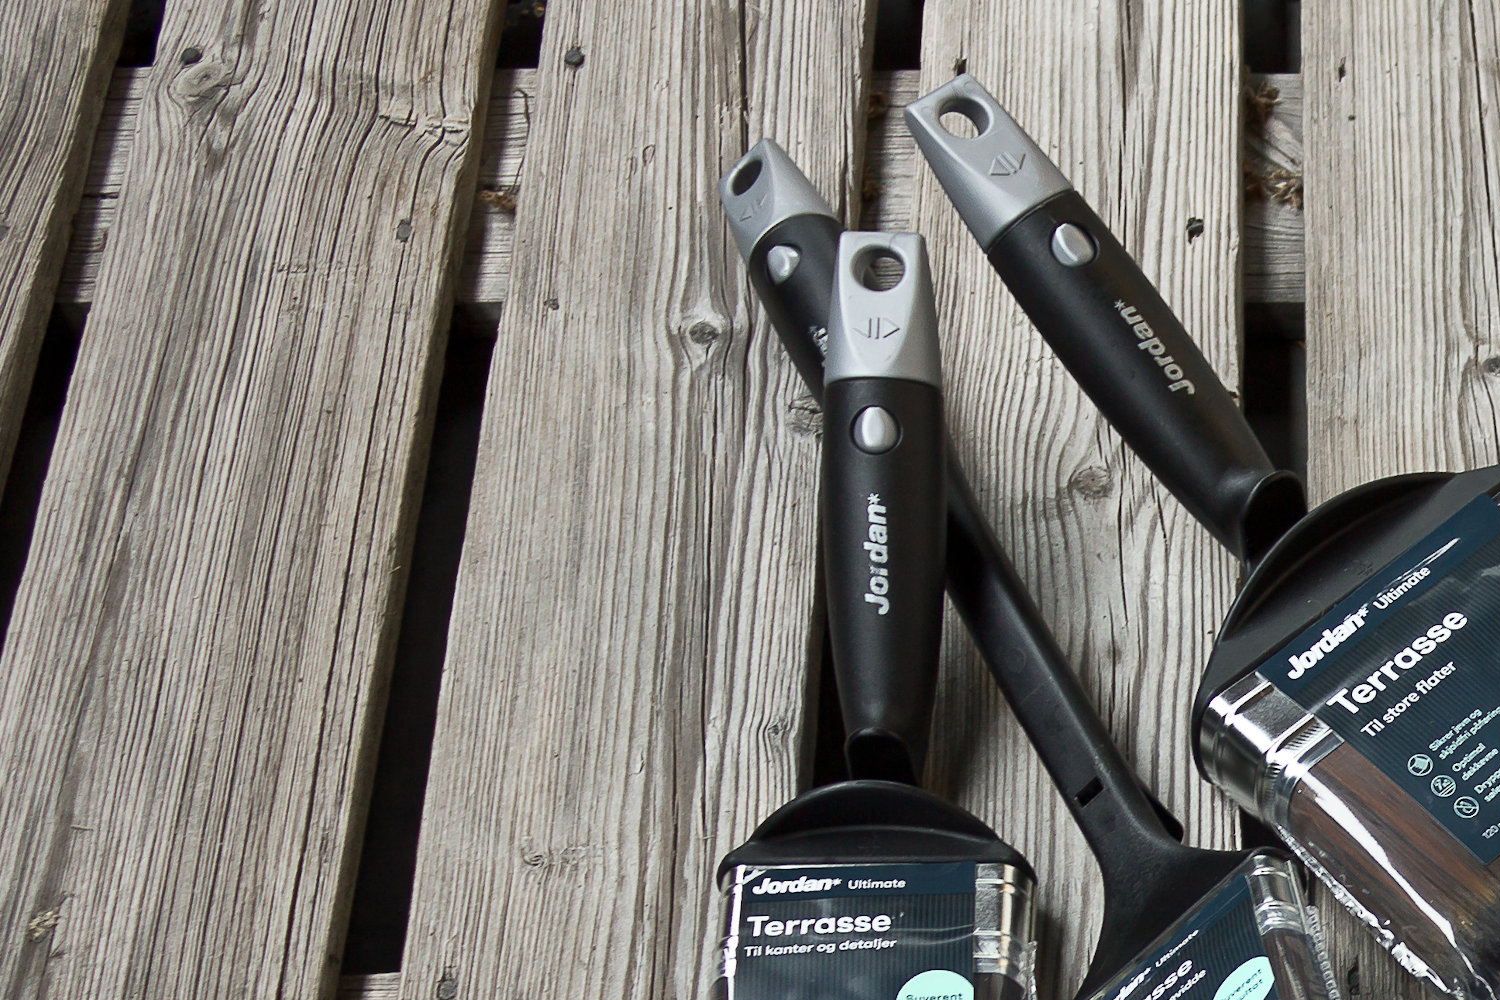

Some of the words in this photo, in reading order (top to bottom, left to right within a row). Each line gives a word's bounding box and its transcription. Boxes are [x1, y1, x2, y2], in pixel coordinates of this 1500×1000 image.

[1373, 567, 1431, 609] Ultimate
[1326, 612, 1468, 714] Terrasse
[1360, 719, 1385, 737] Til
[1383, 692, 1420, 724] store
[1415, 661, 1457, 695] flater
[1469, 709, 1482, 719] og
[1452, 742, 1486, 772] Optimal
[1481, 825, 1499, 839] 120
[848, 879, 906, 890] Ultimate
[747, 914, 891, 937] Terrasse
[744, 946, 761, 957] Til
[765, 943, 814, 956] kanter
[816, 943, 835, 954] og
[839, 938, 897, 951] detaljer
[1155, 930, 1199, 967] Ultimate
